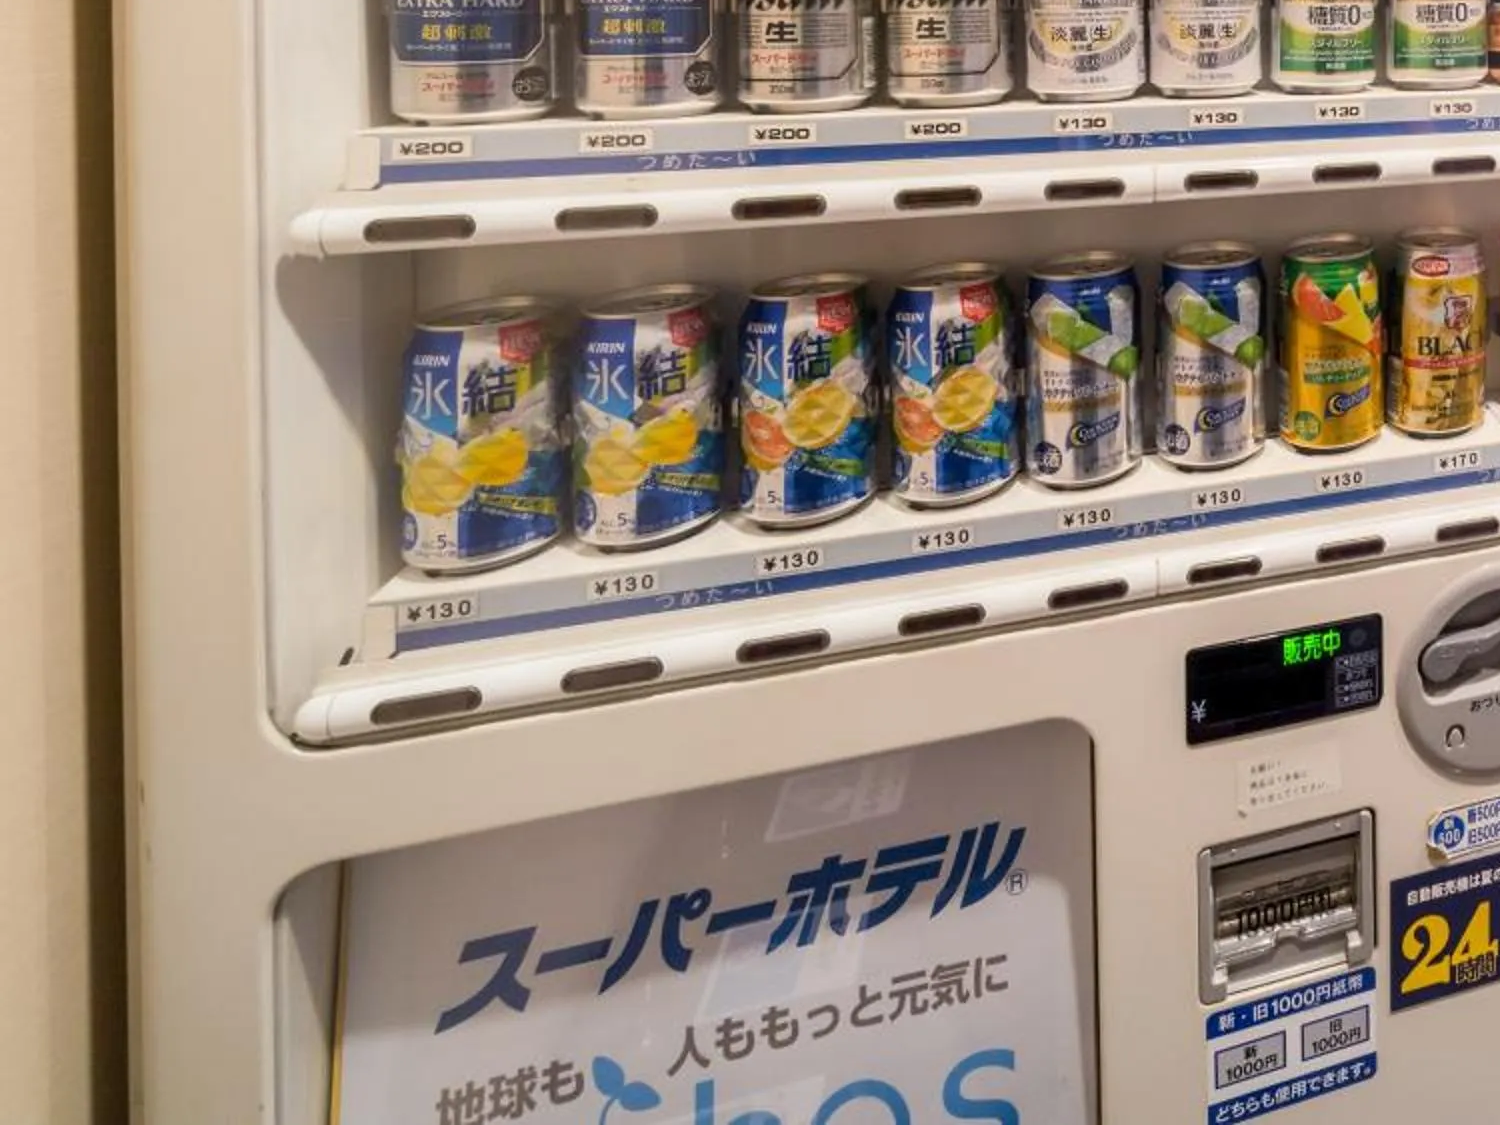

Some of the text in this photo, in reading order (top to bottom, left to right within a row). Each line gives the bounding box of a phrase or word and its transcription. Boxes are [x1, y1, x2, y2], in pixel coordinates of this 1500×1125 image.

[764, 20, 799, 44] 生
[915, 16, 947, 41] 生
[1193, 112, 1238, 124] ¥130
[1318, 106, 1360, 118] ¥130
[1433, 103, 1473, 115] ¥130
[911, 122, 962, 135] ¥200
[1059, 116, 1107, 129] ¥130
[587, 133, 646, 148] ¥200
[754, 128, 811, 141] ¥200
[399, 141, 464, 156] ¥200
[1439, 452, 1479, 470] ¥170
[1321, 471, 1364, 489] ¥130
[1197, 487, 1242, 507] ¥130
[1063, 508, 1112, 527] ¥130
[918, 529, 970, 550] ¥130
[763, 549, 819, 573] ¥130
[594, 573, 655, 597] ¥130
[406, 599, 472, 623] ¥130
[1282, 629, 1341, 667] 販売中
[435, 821, 1026, 1036] スーパーホテル
[1399, 900, 1500, 995] 24
[666, 953, 1010, 1076] 人ももっと元気に
[1329, 1018, 1343, 1034] 旧
[1311, 1025, 1362, 1054] 1000円
[1224, 1053, 1278, 1082] 1000円
[434, 1060, 586, 1125] 地球も
